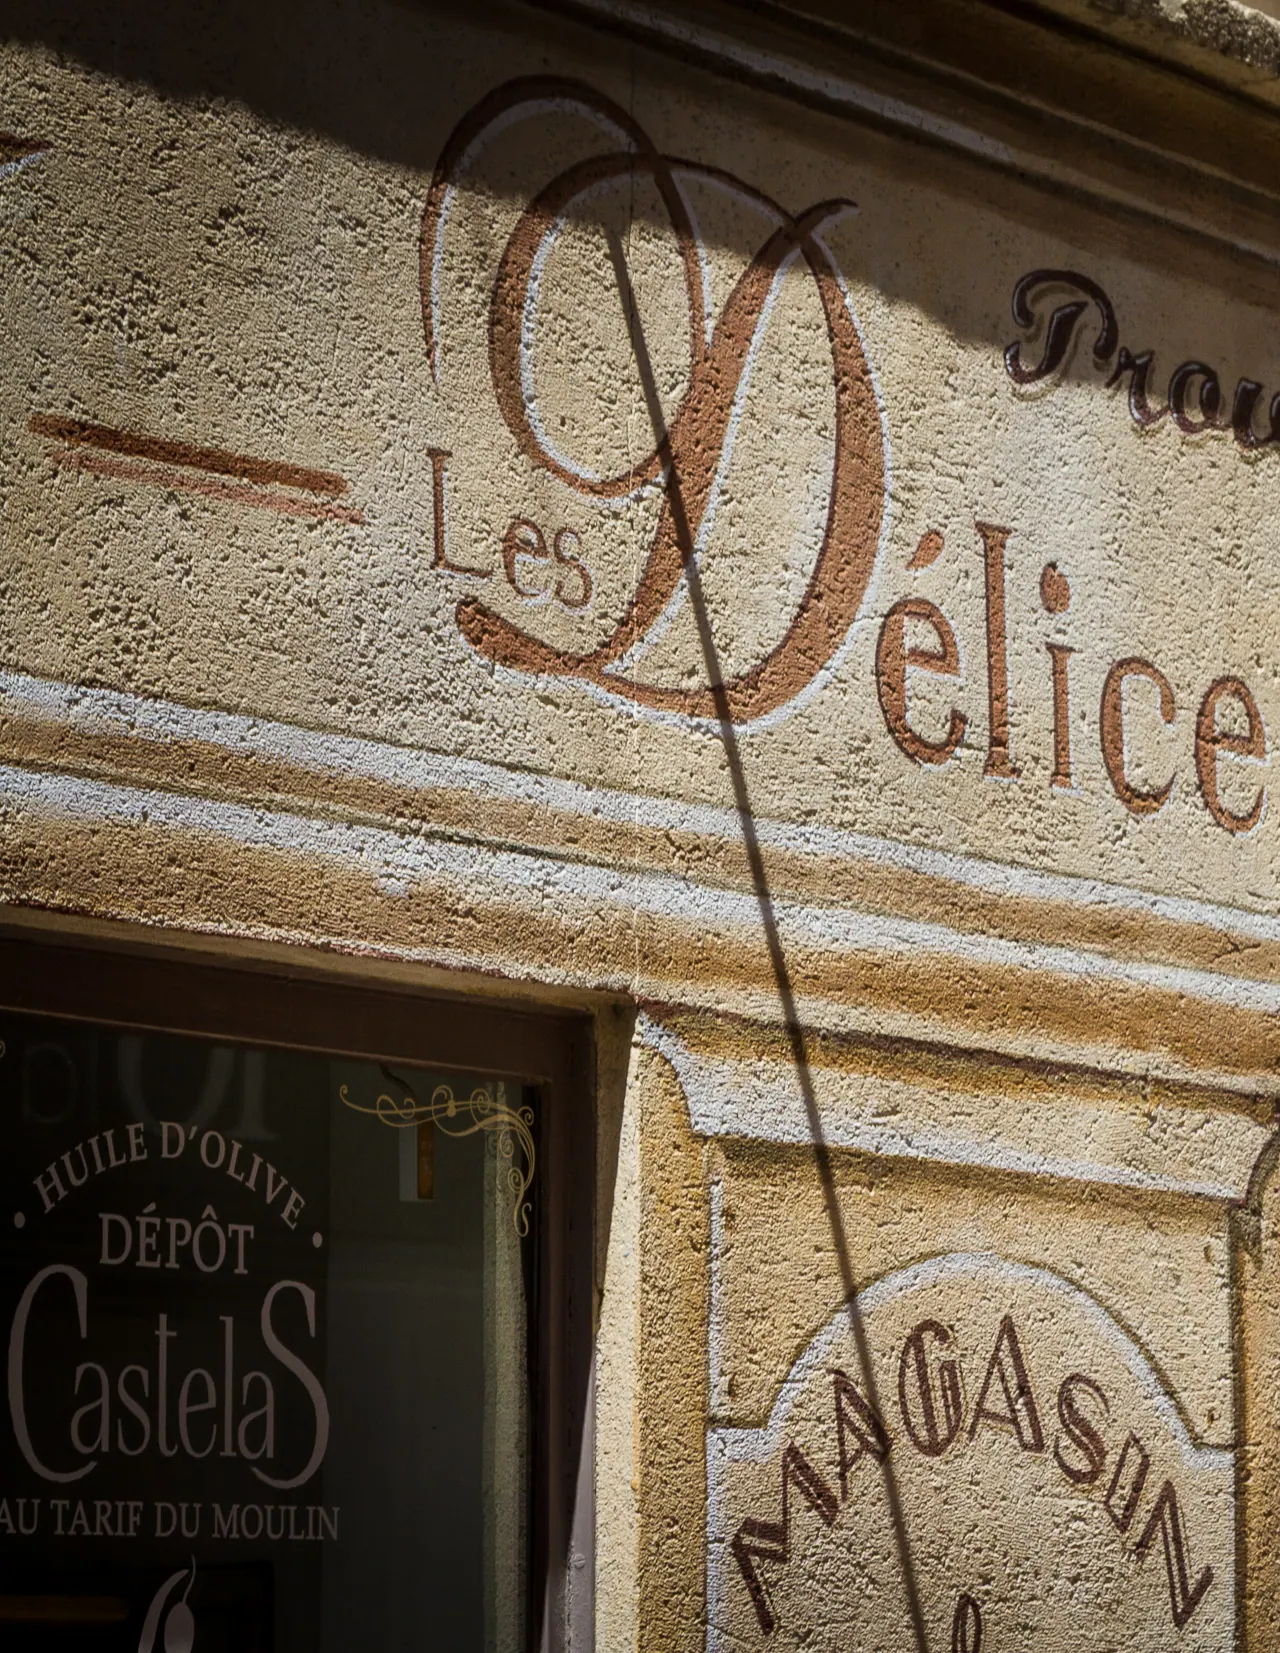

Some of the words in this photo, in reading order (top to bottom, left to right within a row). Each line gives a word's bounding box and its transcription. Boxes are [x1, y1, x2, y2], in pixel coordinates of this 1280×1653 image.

[426, 448, 596, 614] Les
[33, 1121, 148, 1214] HUILE
[160, 1120, 305, 1231] D'OLIVE
[98, 1202, 255, 1275] DÉPÔT
[50, 1498, 144, 1538] TARIF
[154, 1502, 203, 1539] DU
[212, 1503, 340, 1541] MOULIN
[731, 1314, 1214, 1637] MAGASIN
